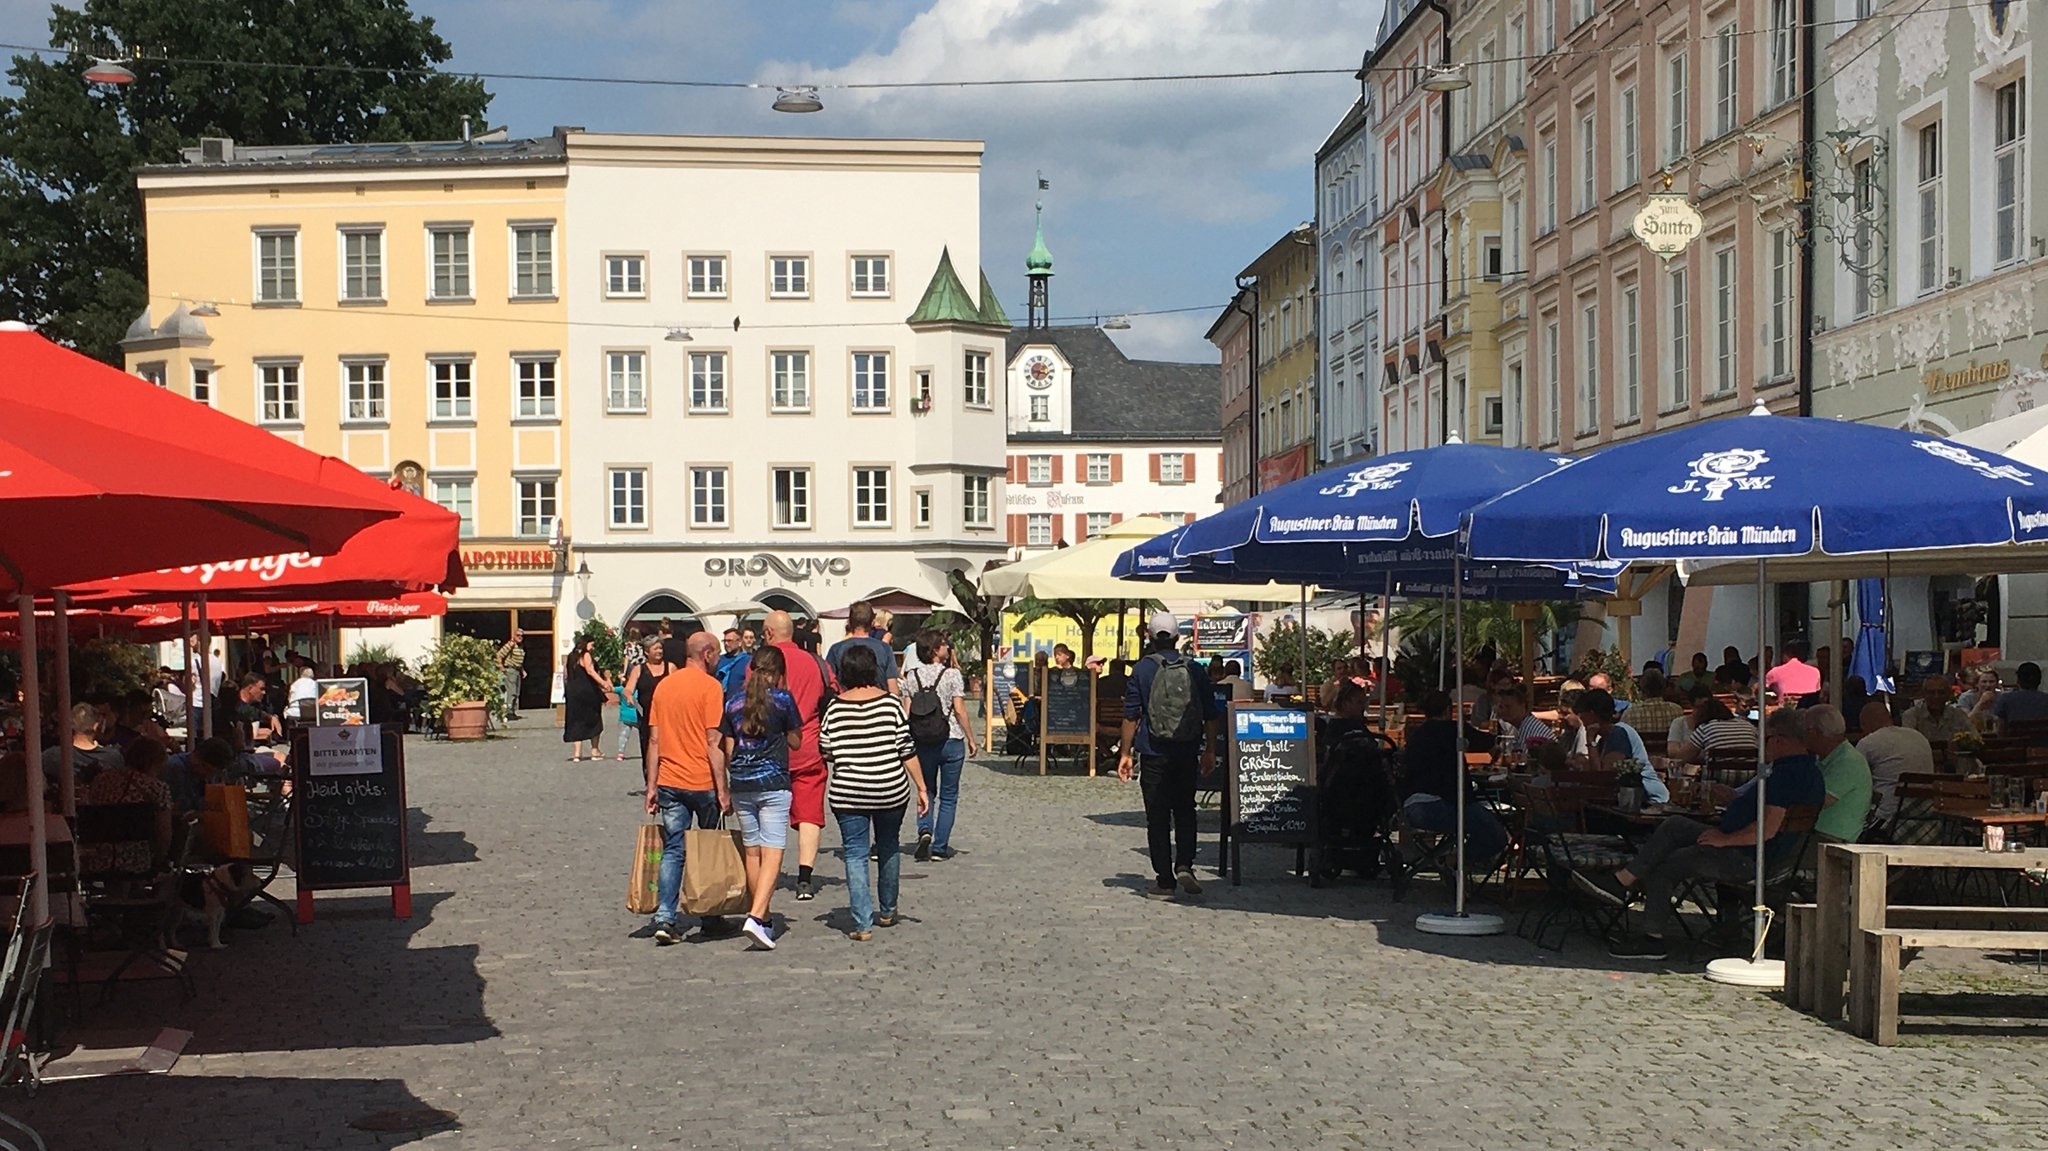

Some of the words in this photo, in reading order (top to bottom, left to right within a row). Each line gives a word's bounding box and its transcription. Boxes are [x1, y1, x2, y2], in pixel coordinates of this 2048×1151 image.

[1641, 214, 1693, 235] Santa
[1357, 516, 1398, 530] München
[1741, 526, 1796, 544] München
[461, 550, 554, 568] APOTHEKE
[366, 601, 420, 614] Flötzinger
[340, 748, 376, 757] WARTEN
[1240, 756, 1292, 771] GRÖSTL
